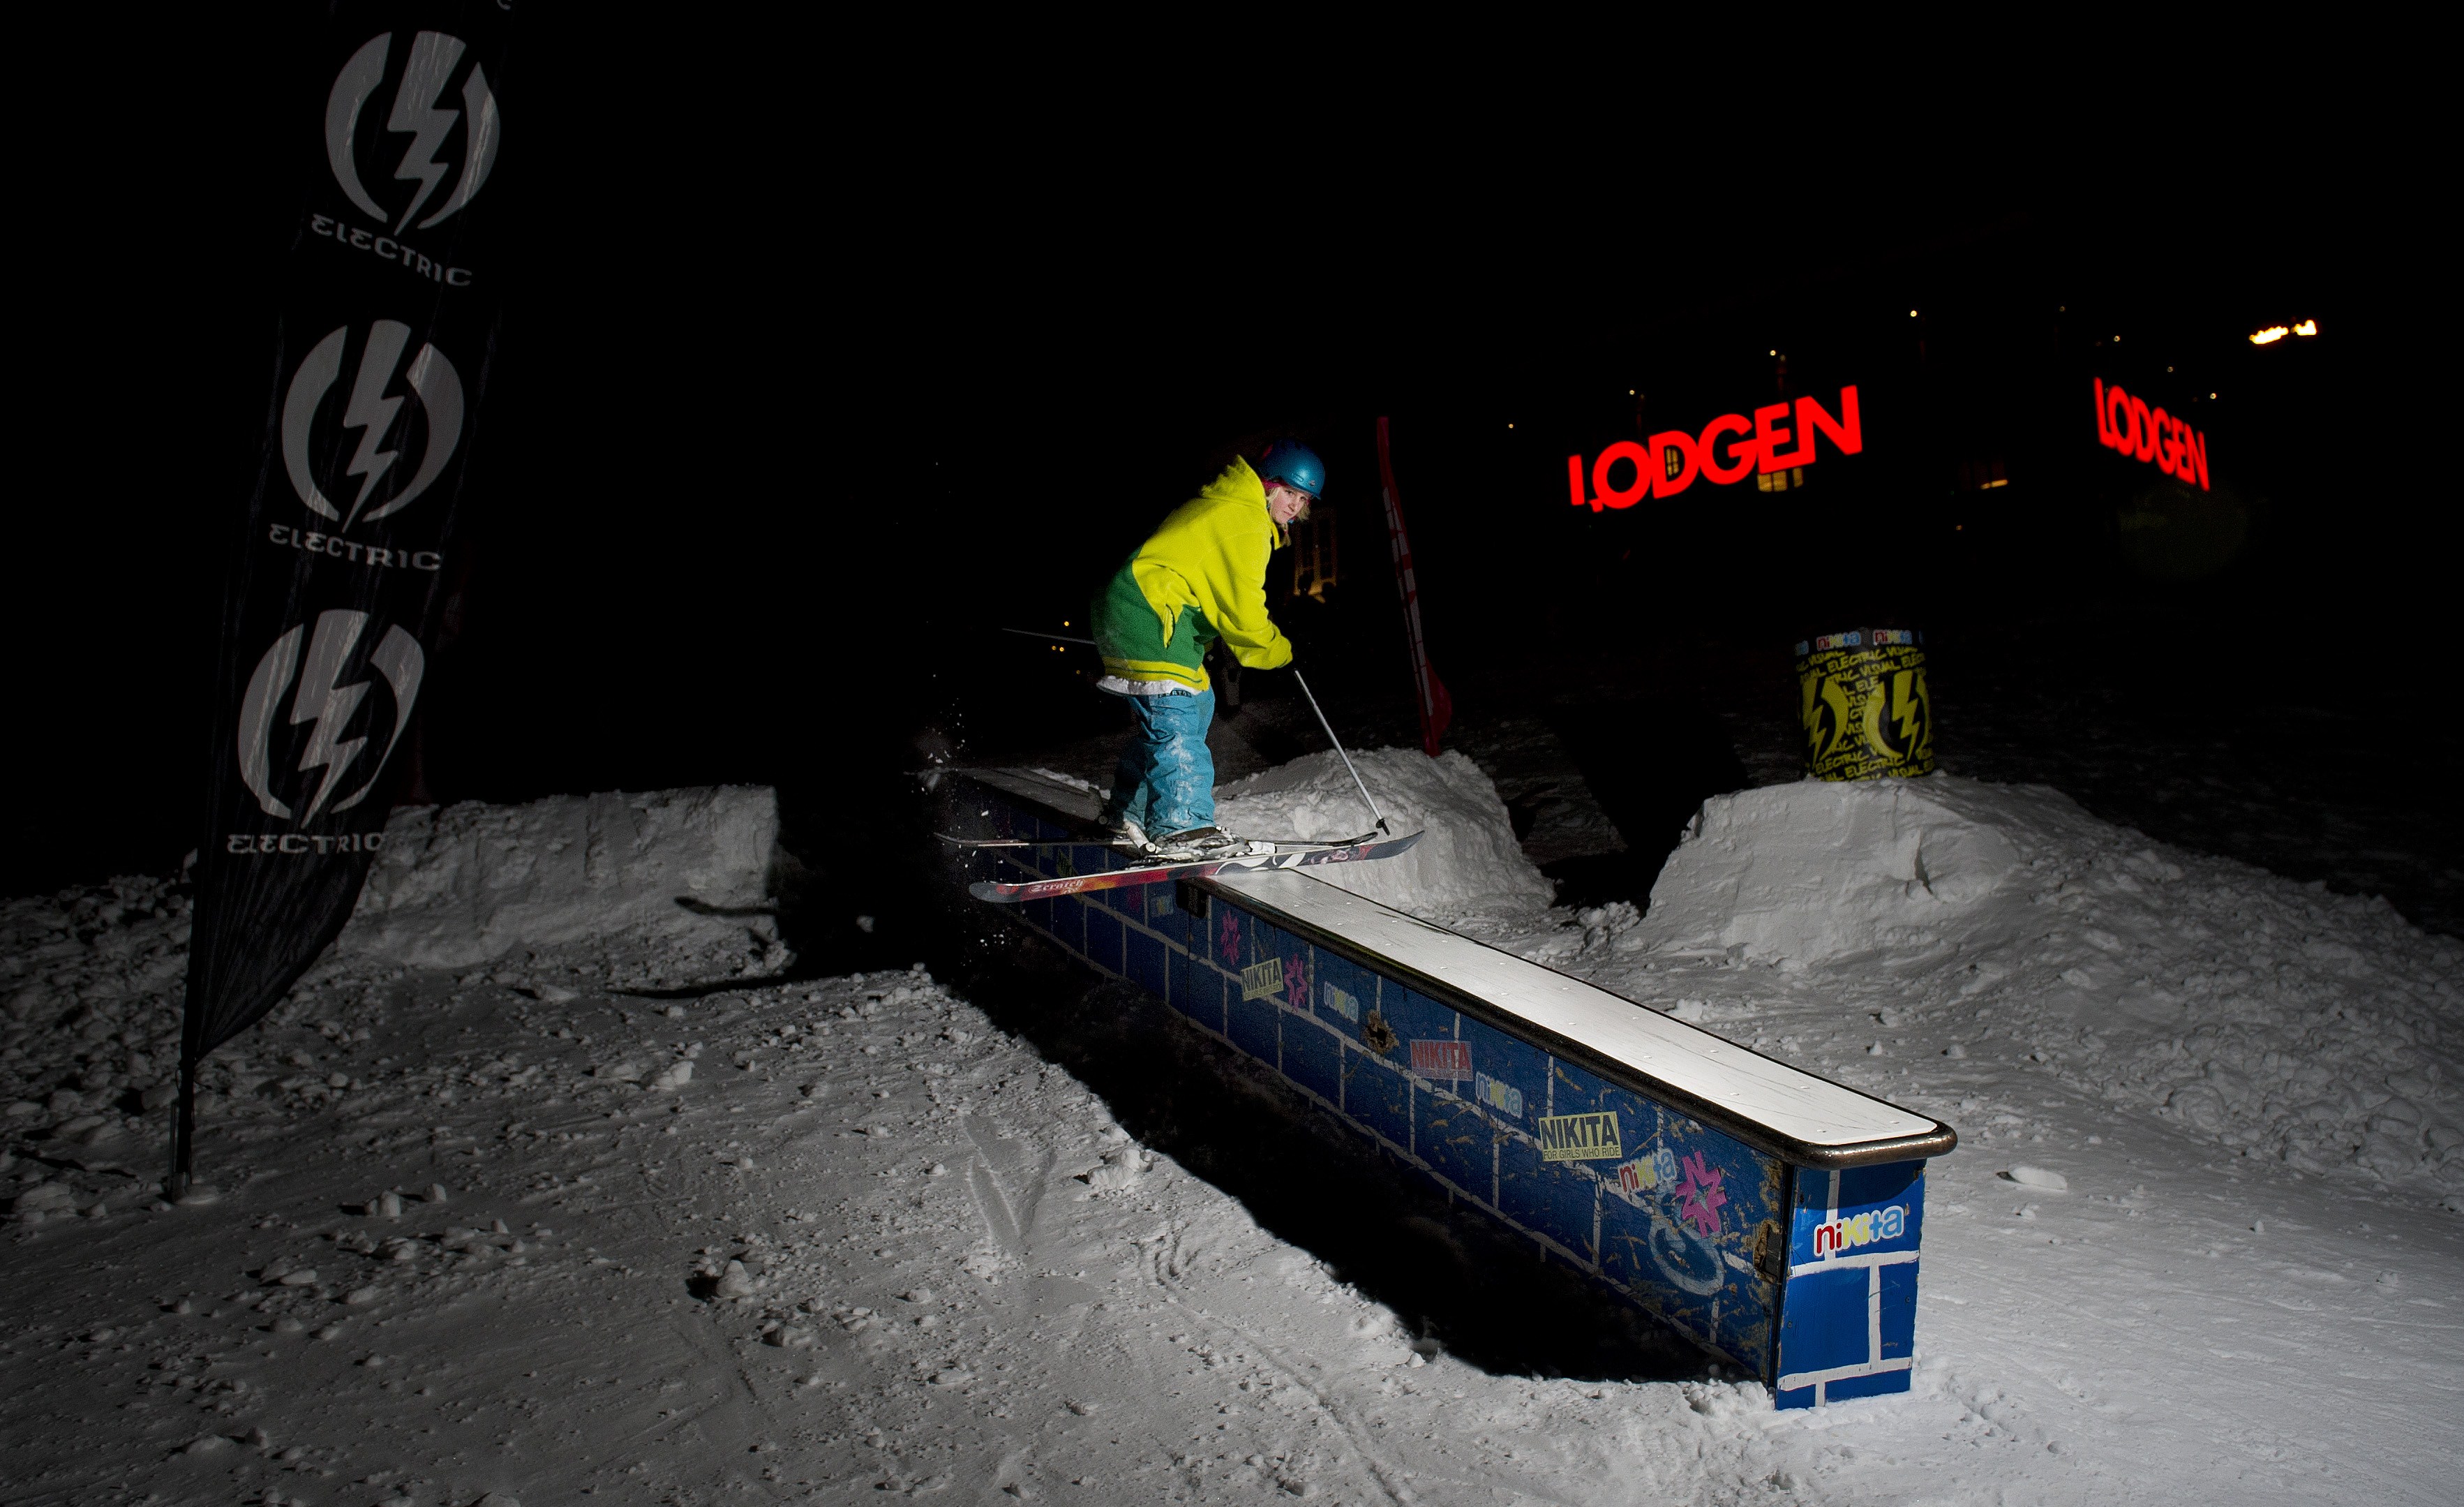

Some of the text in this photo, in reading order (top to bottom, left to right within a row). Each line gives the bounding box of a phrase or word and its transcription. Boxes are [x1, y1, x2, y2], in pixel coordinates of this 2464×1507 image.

[311, 213, 472, 287] ELECTRIC
[1569, 385, 1862, 513] LODGEN
[2094, 377, 2210, 491] LODGEN
[268, 523, 443, 571] ELECTRIC
[1411, 1041, 1472, 1071] NIKITA
[1540, 1115, 1619, 1150] NIKITA
[1544, 1146, 1620, 1160] FOR GIRLS WHO RIDE
